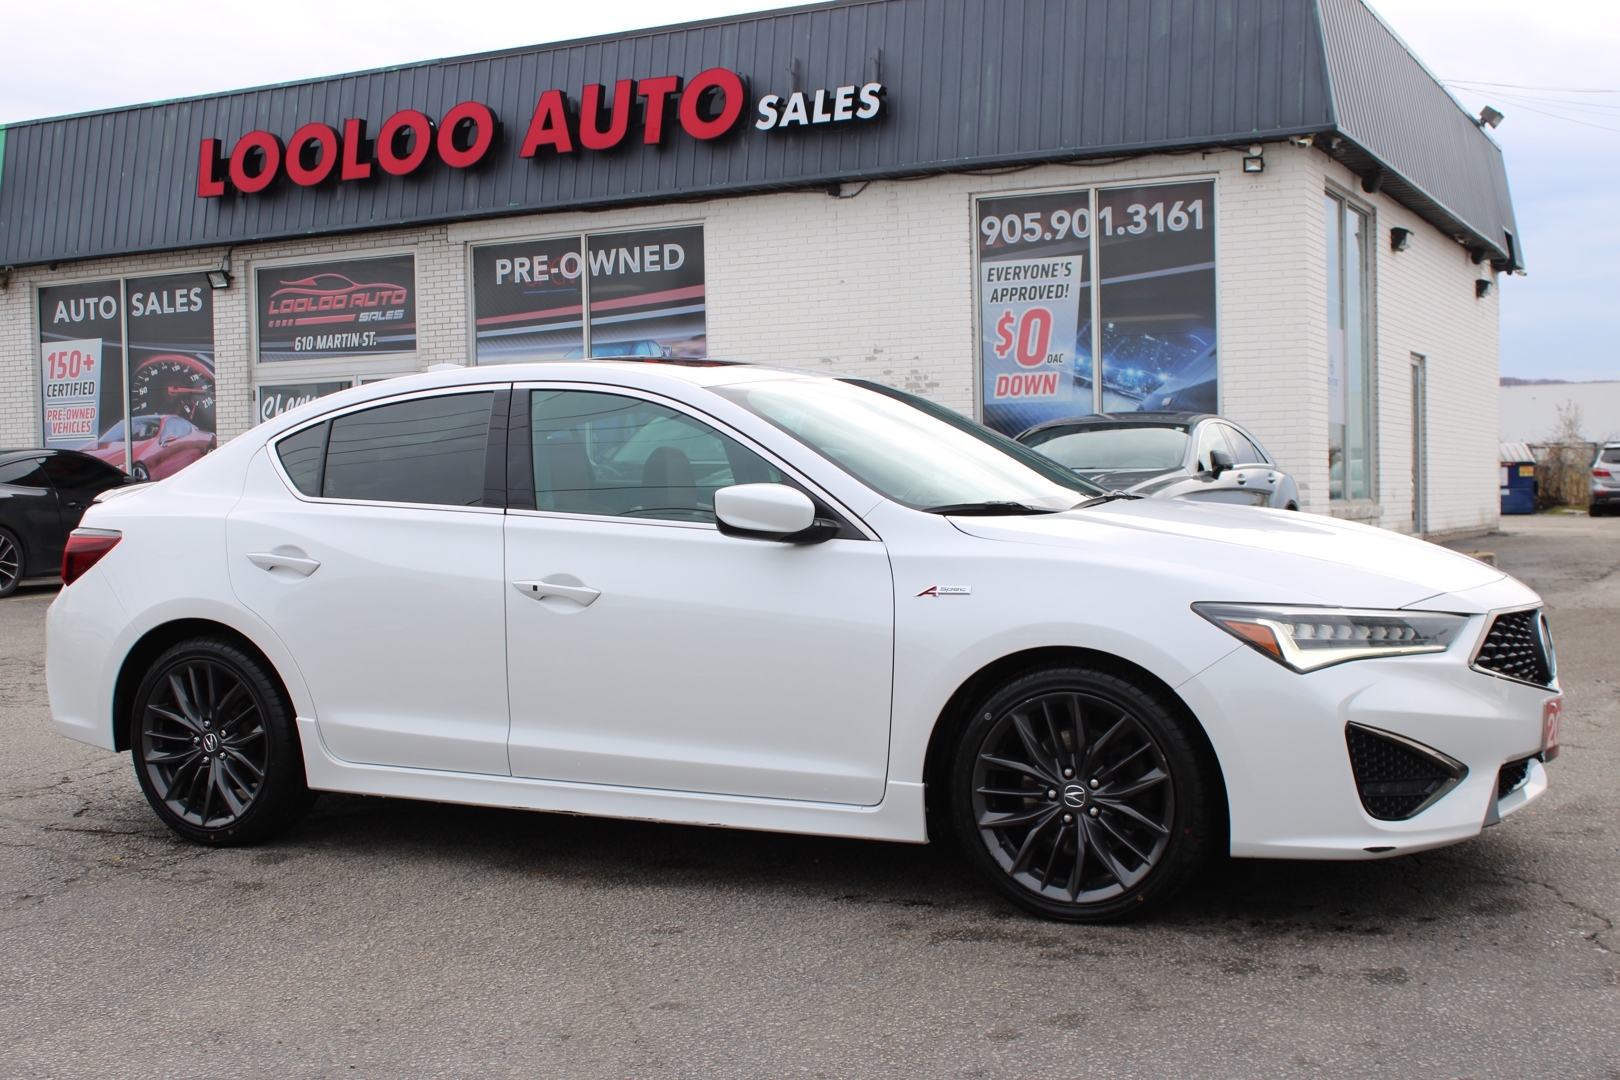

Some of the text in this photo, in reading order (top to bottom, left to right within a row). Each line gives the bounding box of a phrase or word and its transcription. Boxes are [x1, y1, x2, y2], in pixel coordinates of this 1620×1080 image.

[198, 67, 882, 198] LOOLOO AUTO SALES
[981, 199, 1204, 246] 905.901.3161
[495, 243, 685, 285] PRE-OWNED
[987, 262, 1073, 283] EVERYONE'S
[268, 289, 408, 315] LOOLOO AUTO
[990, 283, 1070, 303] APPROVED!
[53, 287, 203, 324] AUTO SALES
[358, 309, 405, 323] SALES
[294, 331, 378, 352] 610 MARTIN ST.
[995, 308, 1052, 367] $0
[47, 350, 95, 380] 150+
[1046, 353, 1064, 364] OAC
[46, 381, 95, 398] CERTIFIED
[996, 373, 1058, 397] DOWN
[47, 407, 96, 422] PRE-OWNED
[52, 420, 92, 434] VEHICLES
